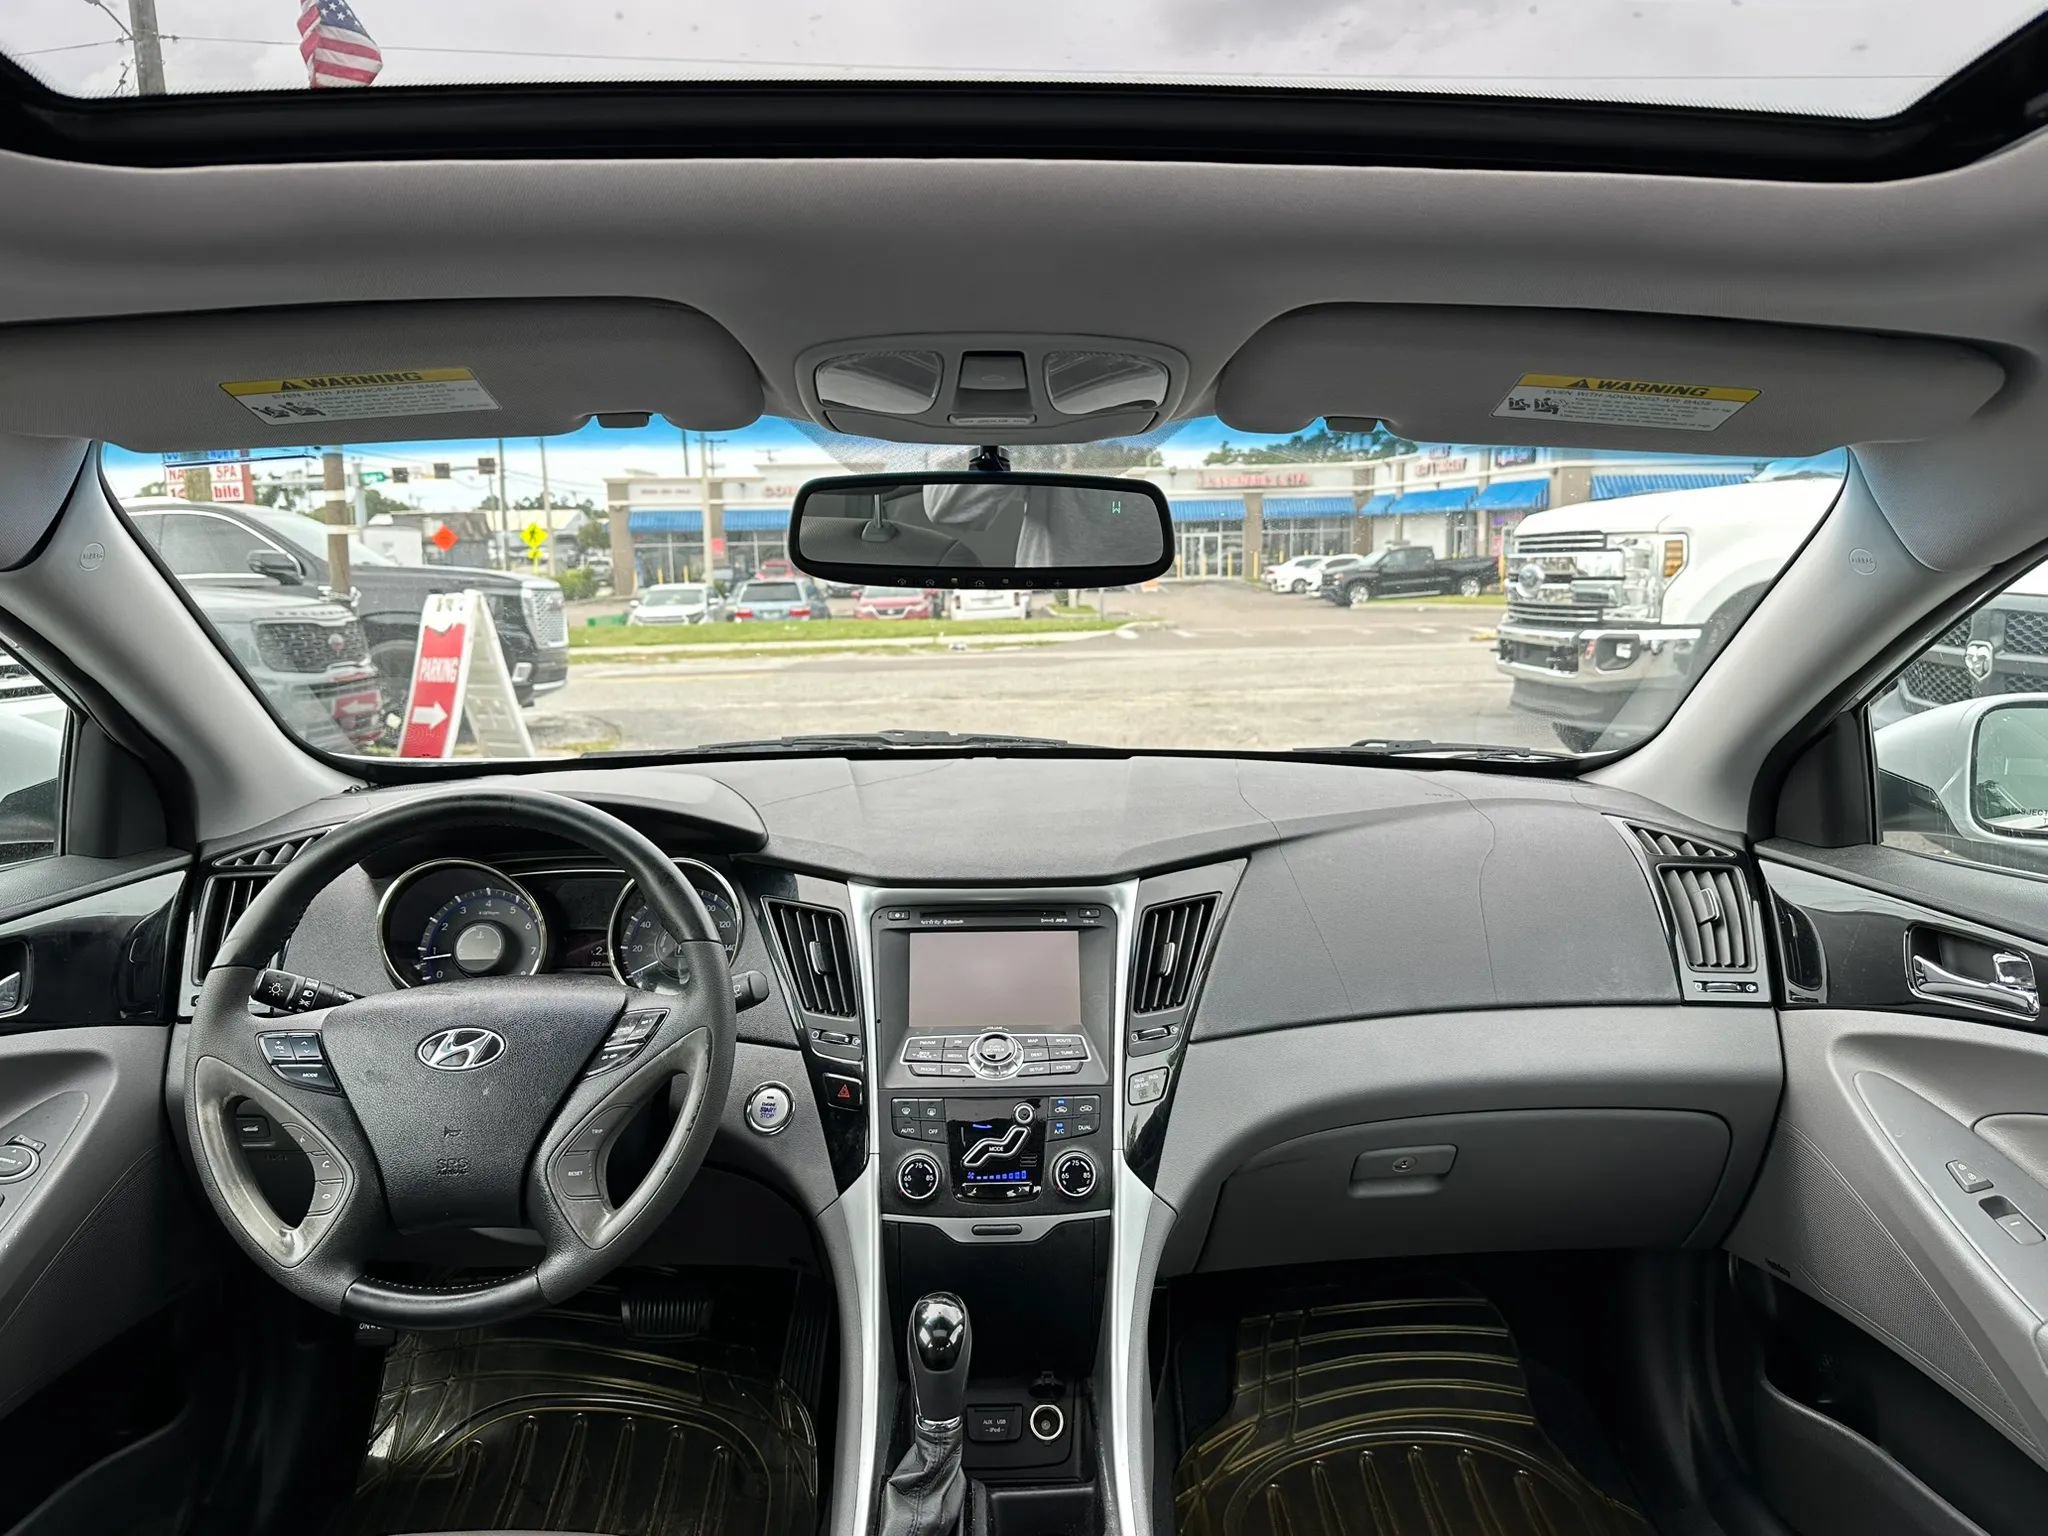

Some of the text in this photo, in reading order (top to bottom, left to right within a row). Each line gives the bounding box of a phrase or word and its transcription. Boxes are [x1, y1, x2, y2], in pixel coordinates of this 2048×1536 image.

[303, 371, 424, 389] WARNING
[1597, 380, 1710, 397] WARNING
[216, 465, 237, 478] SPA
[214, 485, 240, 498] bile
[418, 657, 459, 683] PARKING
[441, 922, 449, 931] 2
[525, 921, 532, 930] 6
[632, 944, 643, 953] 20
[436, 970, 443, 979] 0
